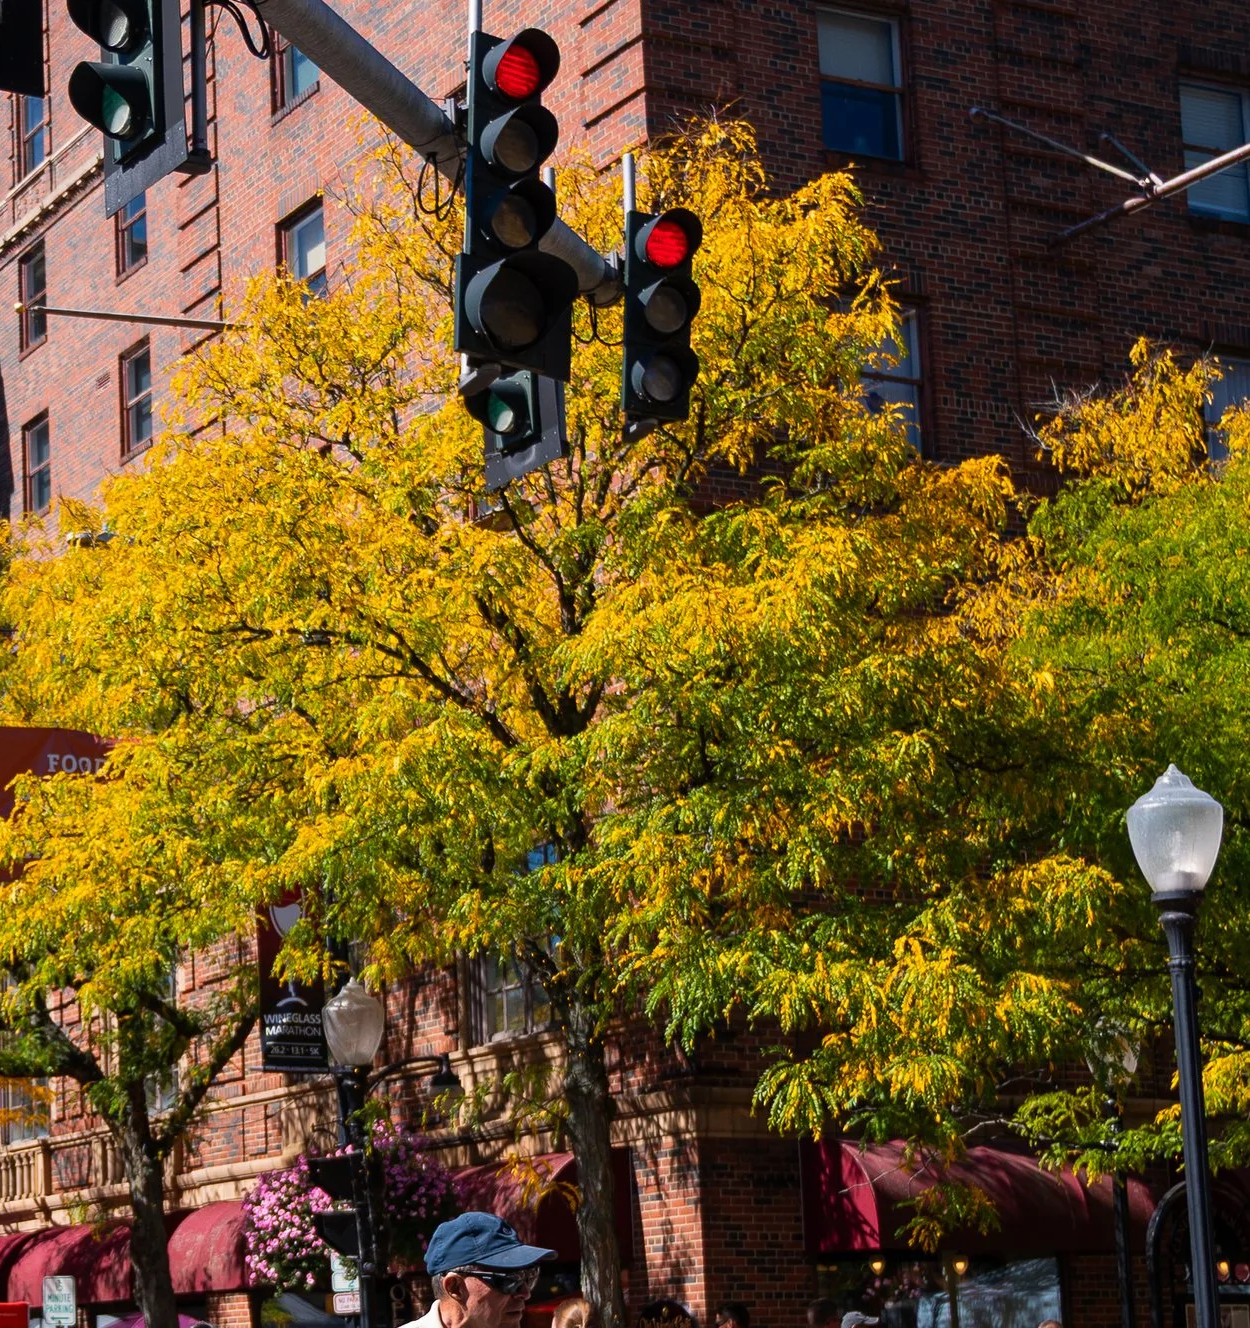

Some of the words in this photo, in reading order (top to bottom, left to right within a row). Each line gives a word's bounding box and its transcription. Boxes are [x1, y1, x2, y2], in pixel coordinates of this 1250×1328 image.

[264, 1013, 321, 1024] WINEGLASS
[265, 1025, 321, 1036] MARATHON
[45, 1304, 74, 1313] PARKING
